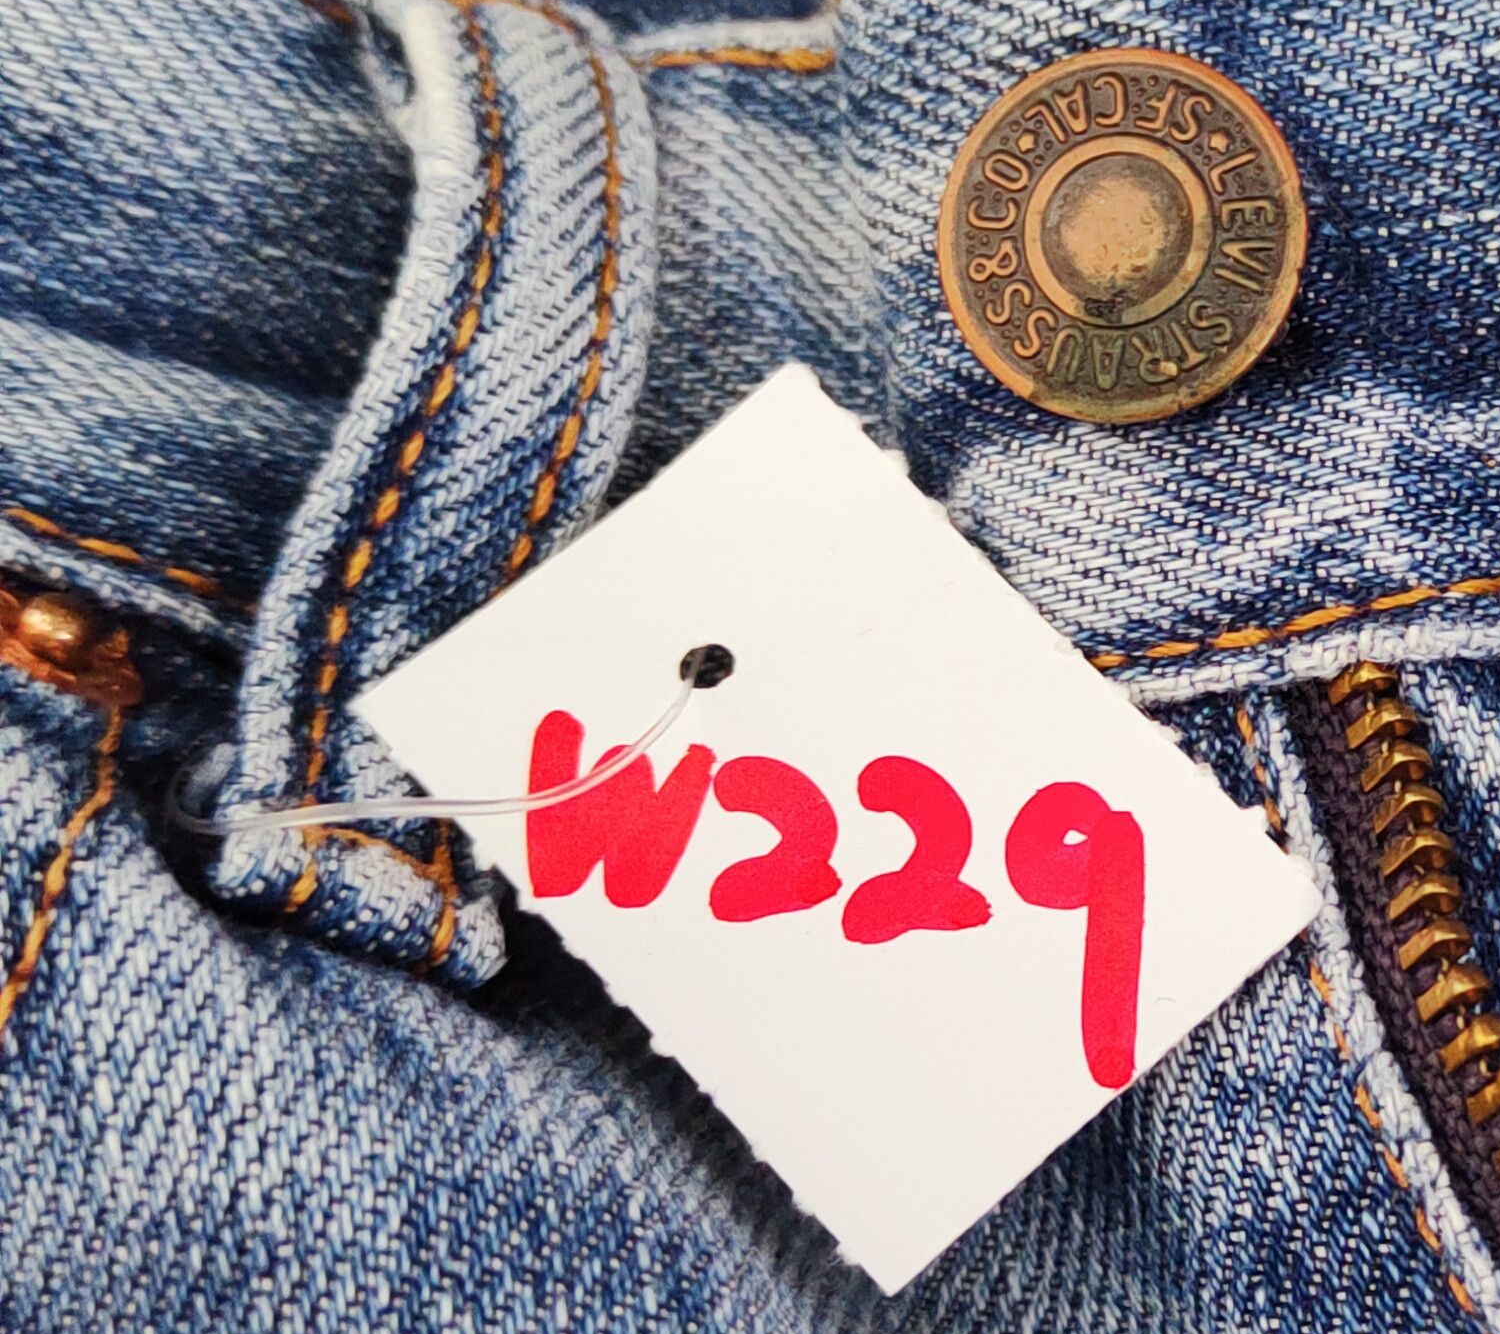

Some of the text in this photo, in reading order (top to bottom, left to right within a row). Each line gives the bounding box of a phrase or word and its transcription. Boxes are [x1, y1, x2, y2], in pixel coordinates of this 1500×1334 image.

[1021, 71, 1127, 144] CAL
[966, 149, 1284, 391] LEVI STRAUSS & CO
[526, 710, 1145, 1090] W229
